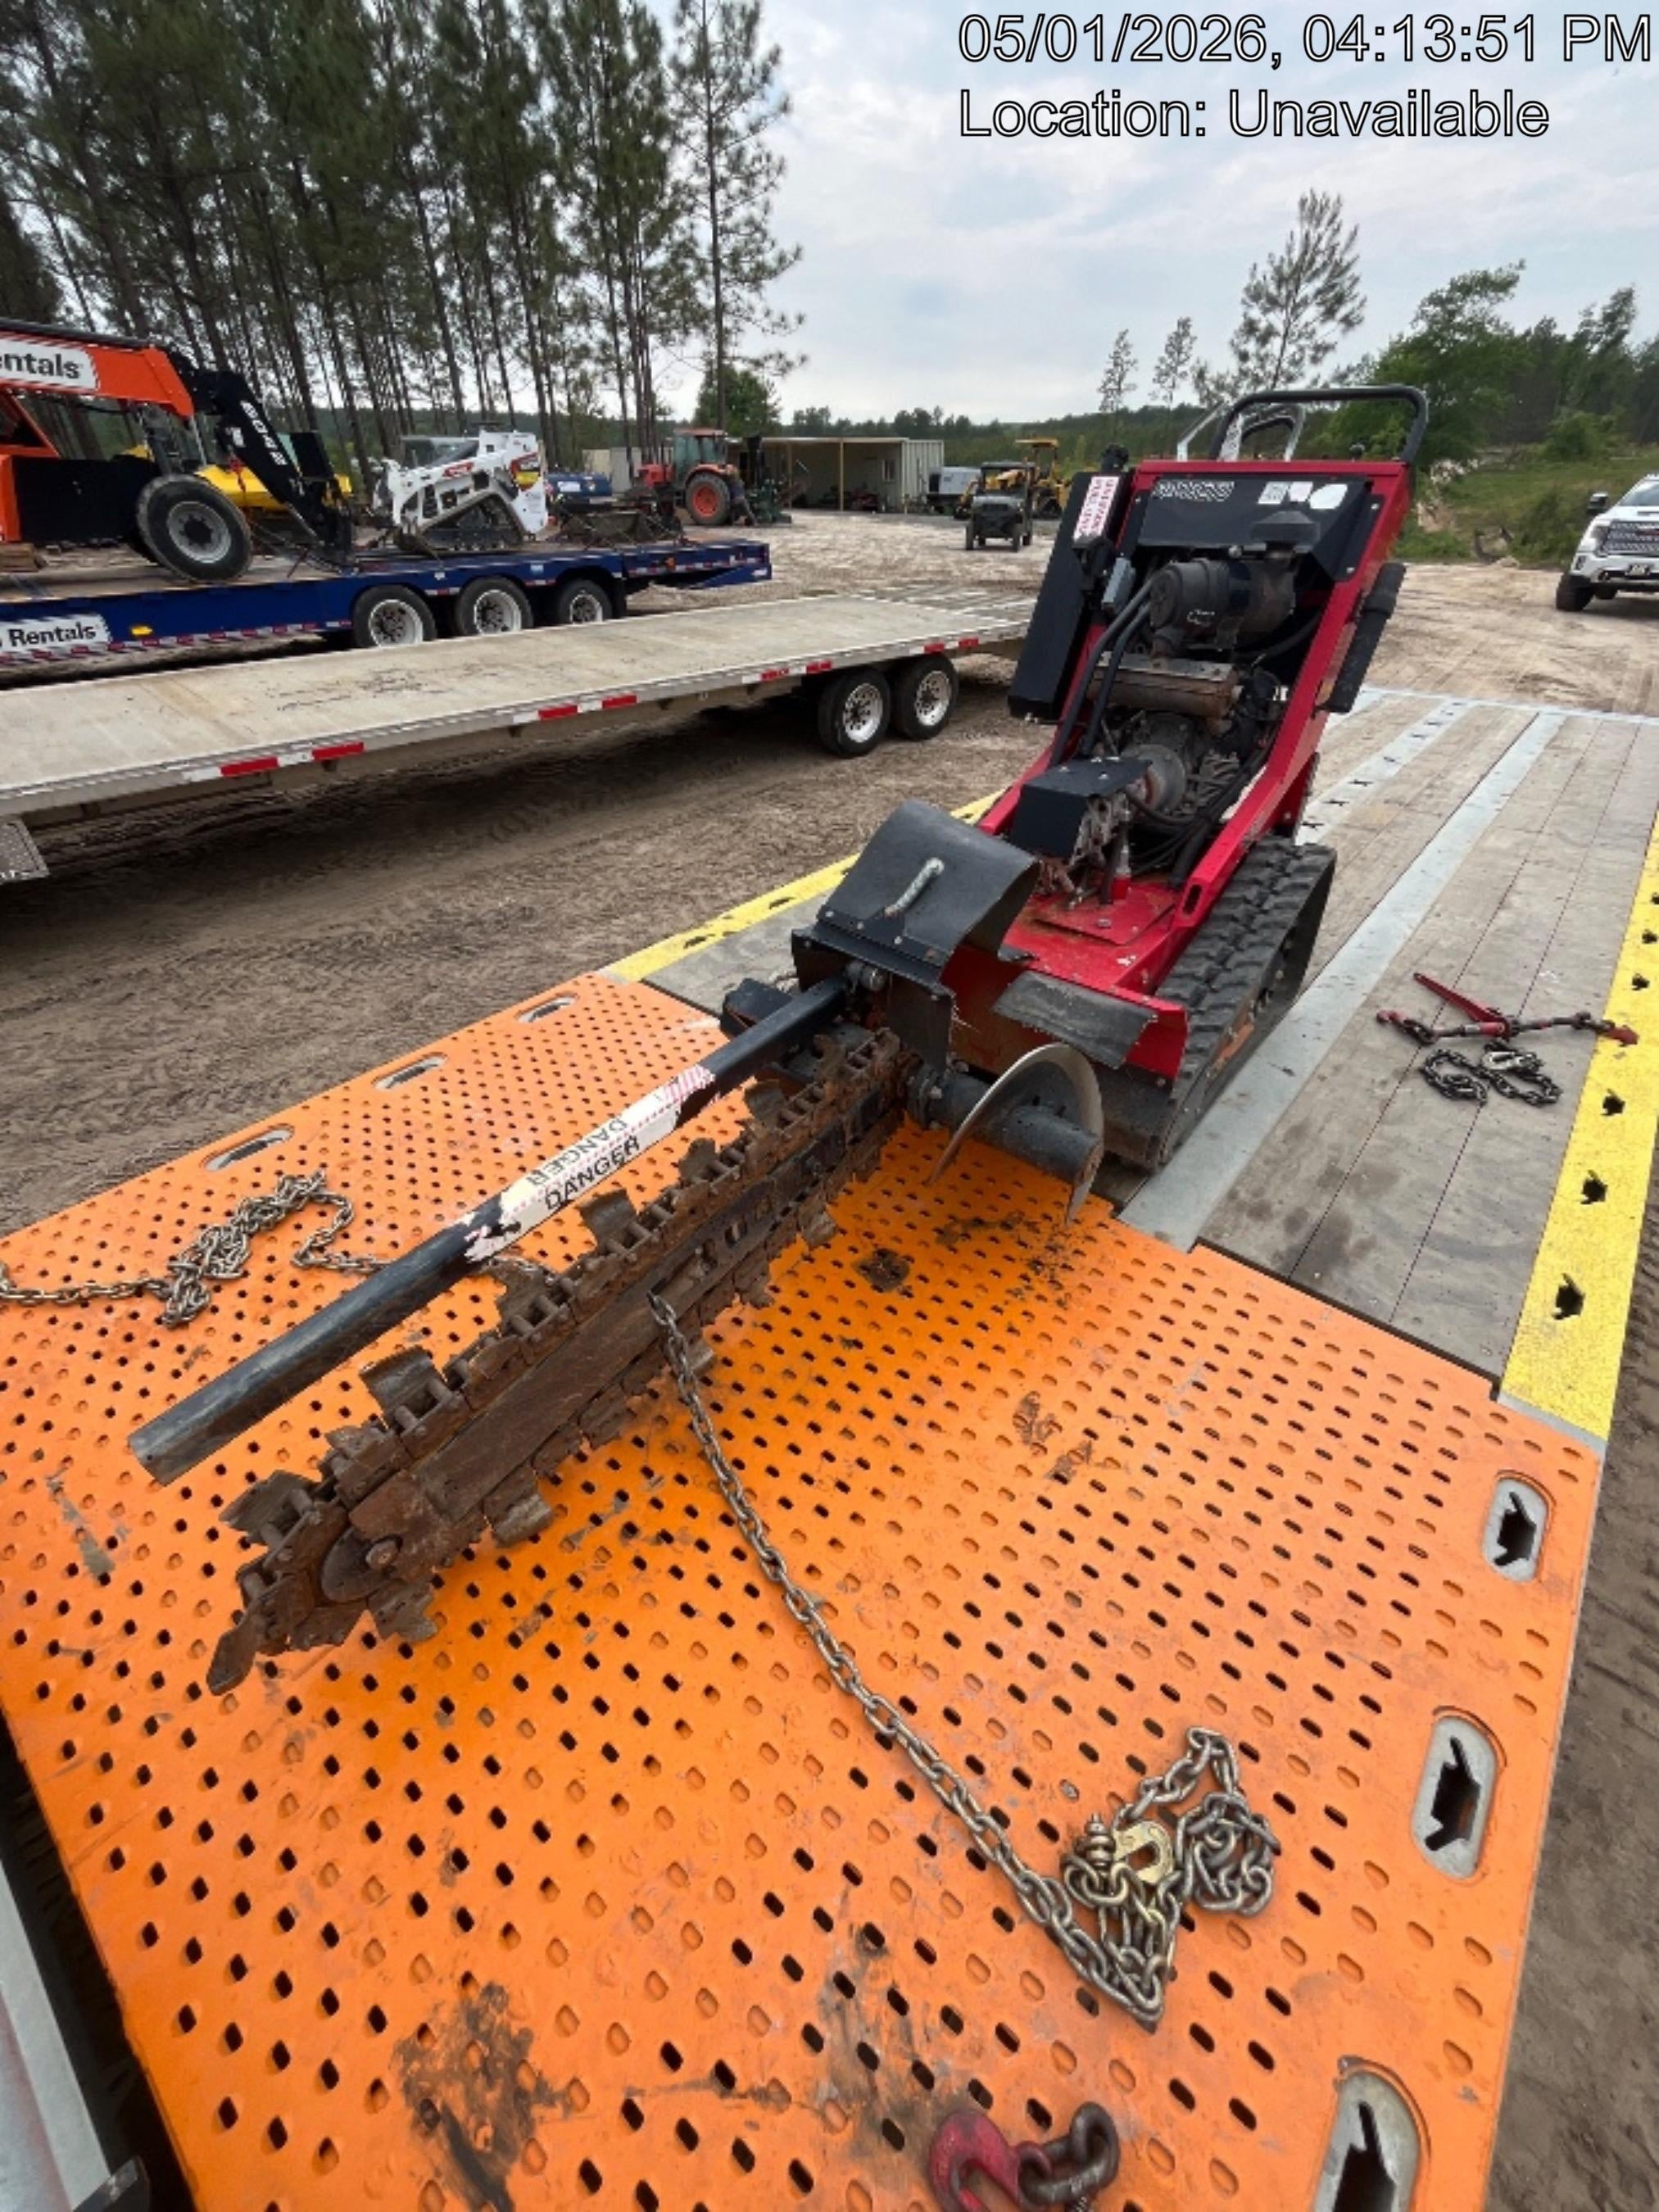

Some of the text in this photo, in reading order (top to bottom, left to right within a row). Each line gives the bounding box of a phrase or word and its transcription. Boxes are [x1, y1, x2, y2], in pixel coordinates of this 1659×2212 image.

[0, 353, 79, 379] ntals
[8, 622, 97, 646] Rentals
[526, 1115, 628, 1186] DANGER
[545, 1136, 641, 1210] DANGER
